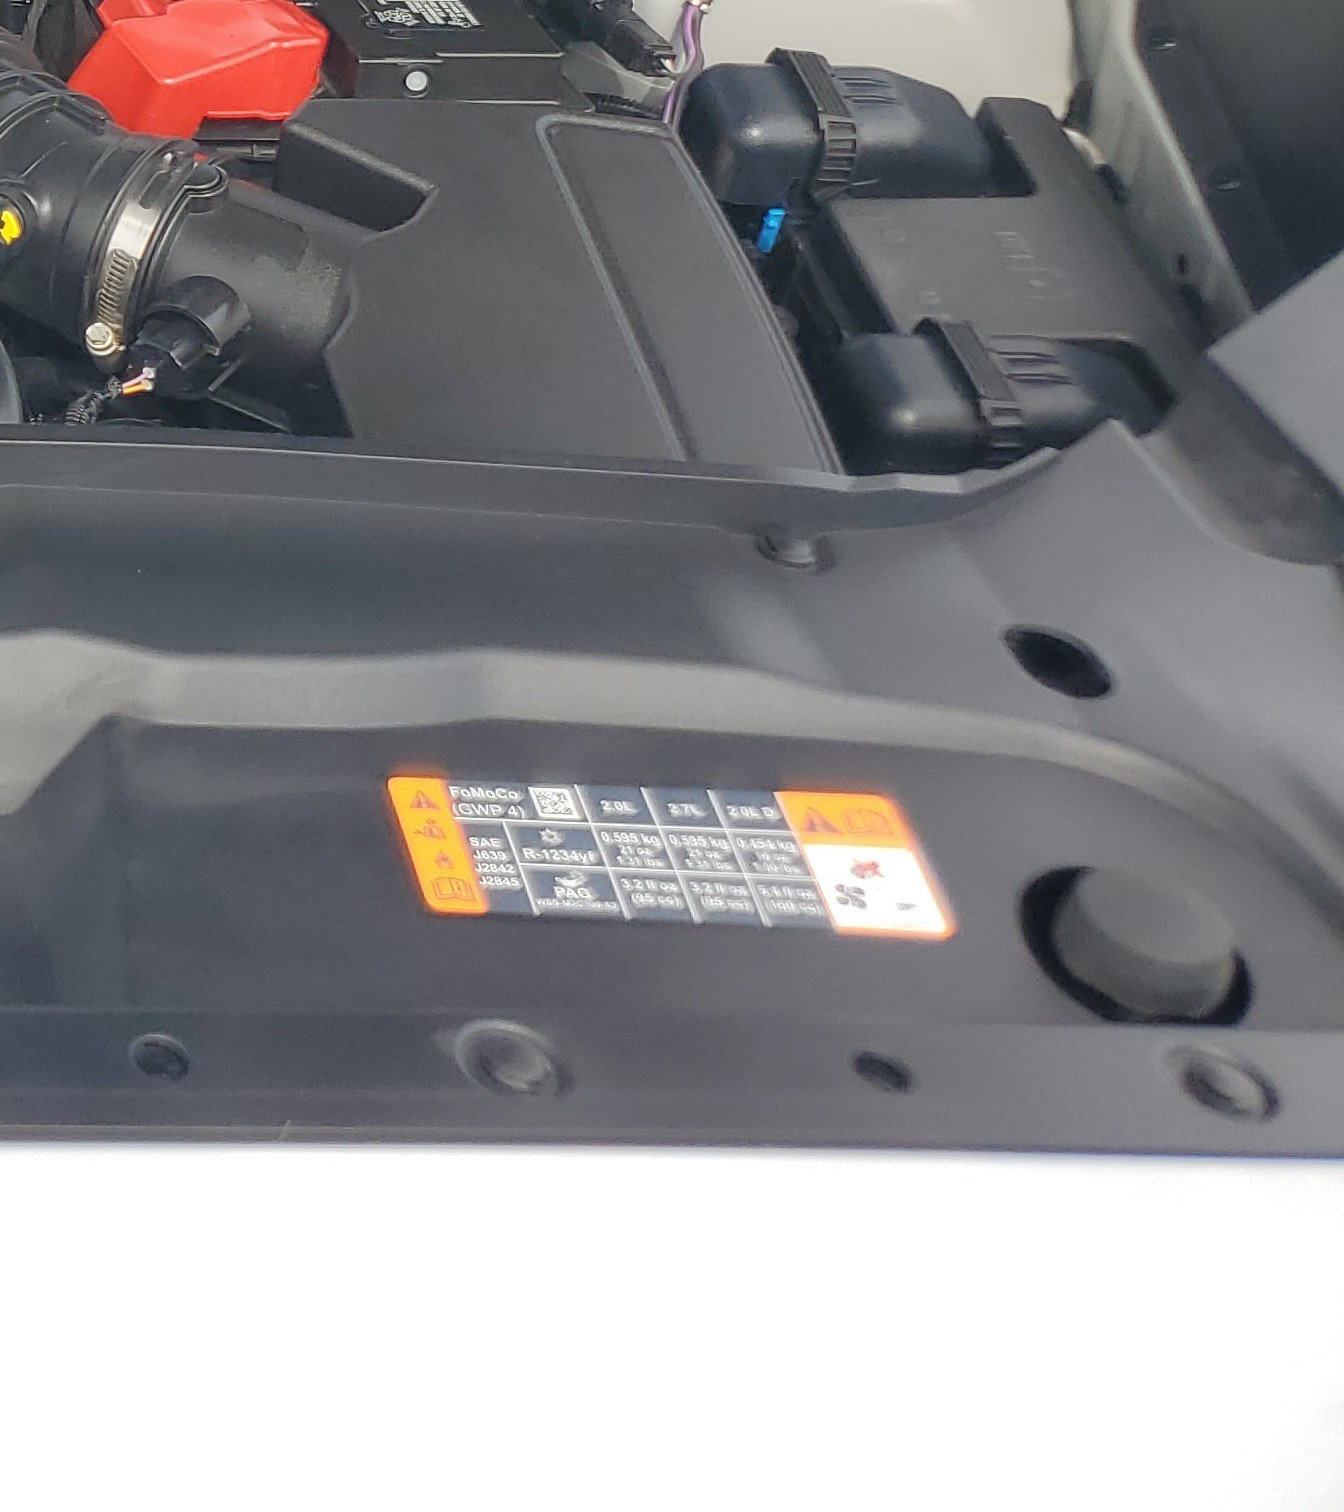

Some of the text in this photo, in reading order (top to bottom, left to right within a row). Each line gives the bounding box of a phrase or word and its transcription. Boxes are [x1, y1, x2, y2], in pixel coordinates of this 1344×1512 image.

[449, 785, 520, 800] FoMoCo
[506, 804, 526, 819] 4)
[599, 799, 639, 814] 2.0L
[469, 837, 502, 849] SAE
[521, 846, 596, 864] R-1234yf
[474, 862, 516, 876] J2842
[479, 875, 521, 889] J2845
[552, 885, 593, 900] PAG
